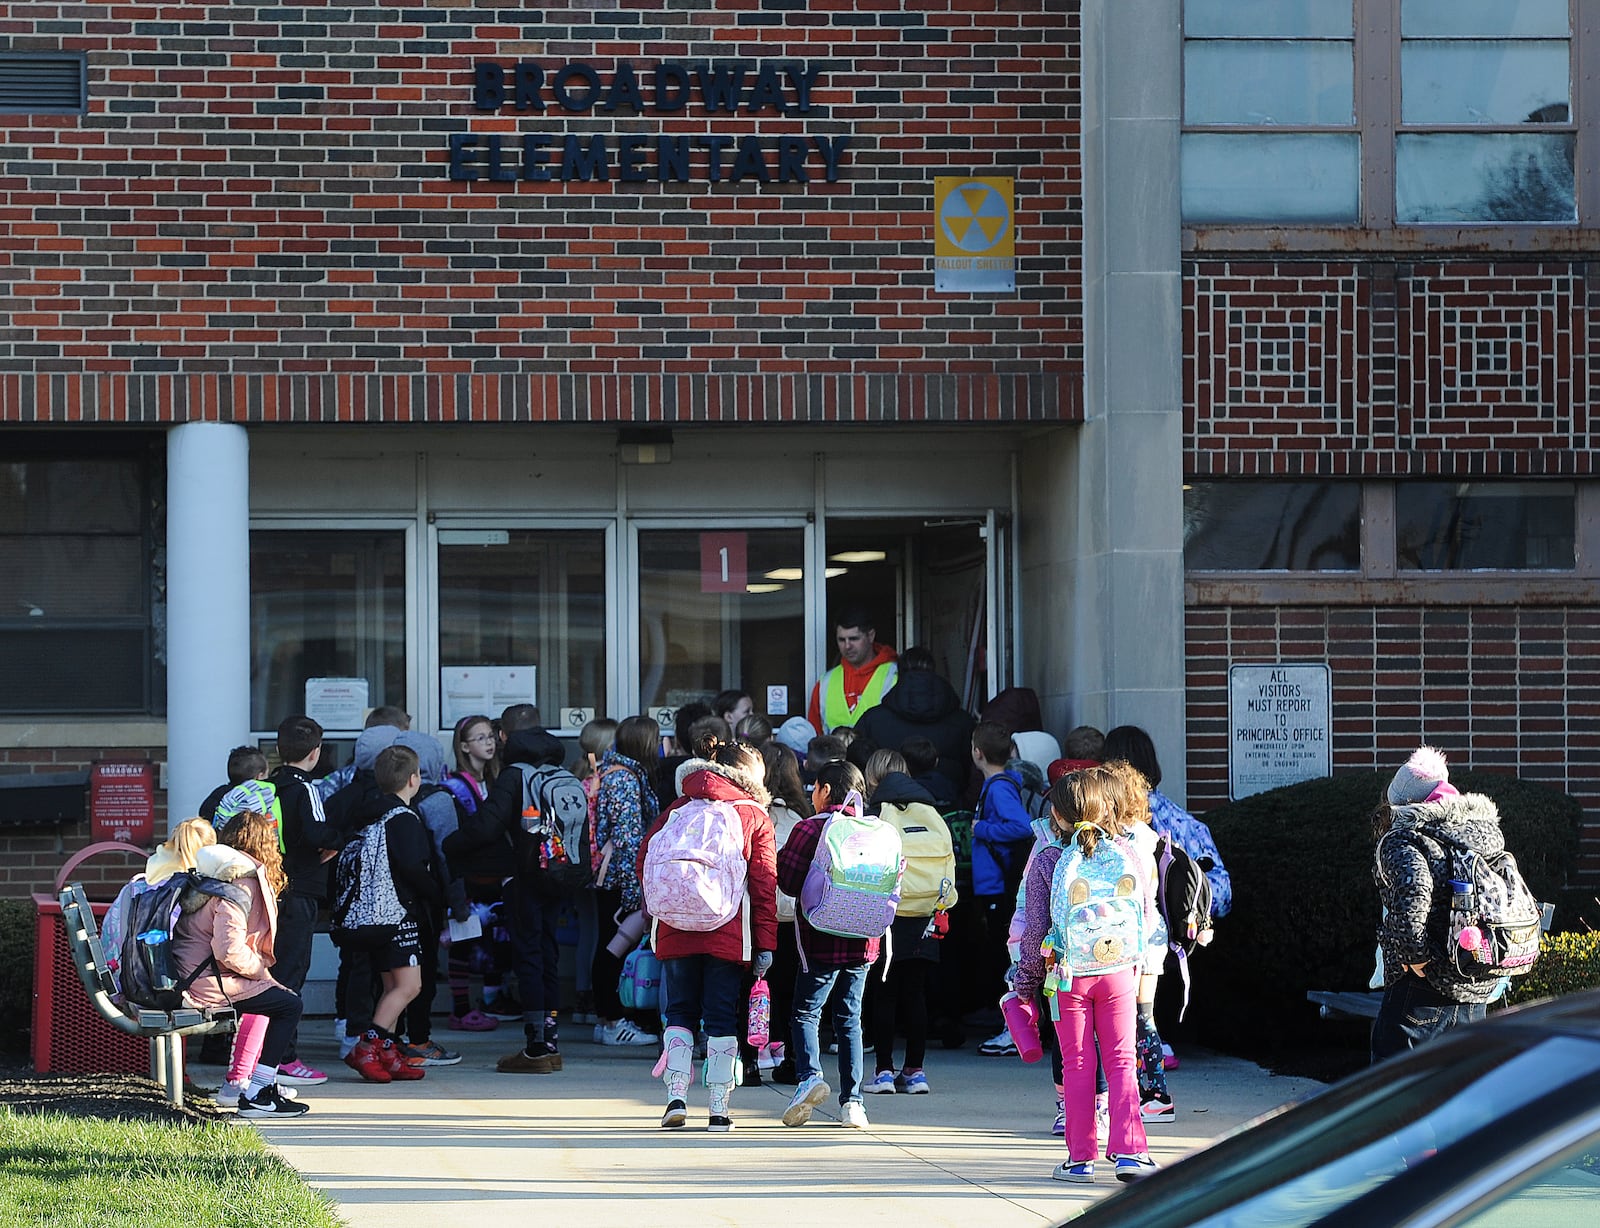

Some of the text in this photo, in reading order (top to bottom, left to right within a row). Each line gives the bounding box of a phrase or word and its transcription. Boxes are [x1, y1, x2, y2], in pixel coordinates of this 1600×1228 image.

[474, 63, 821, 111] BROADWAY
[449, 134, 850, 182] ELEMENTARY
[937, 259, 1013, 270] FALLOUT SHELTER
[719, 547, 729, 582] 1
[1270, 670, 1289, 682] ALL
[1258, 685, 1301, 697] VISITORS
[1248, 699, 1311, 712] MUST REPORT
[1275, 714, 1287, 726] TO
[1237, 728, 1324, 741] PRINCIPAL'S OFFICE
